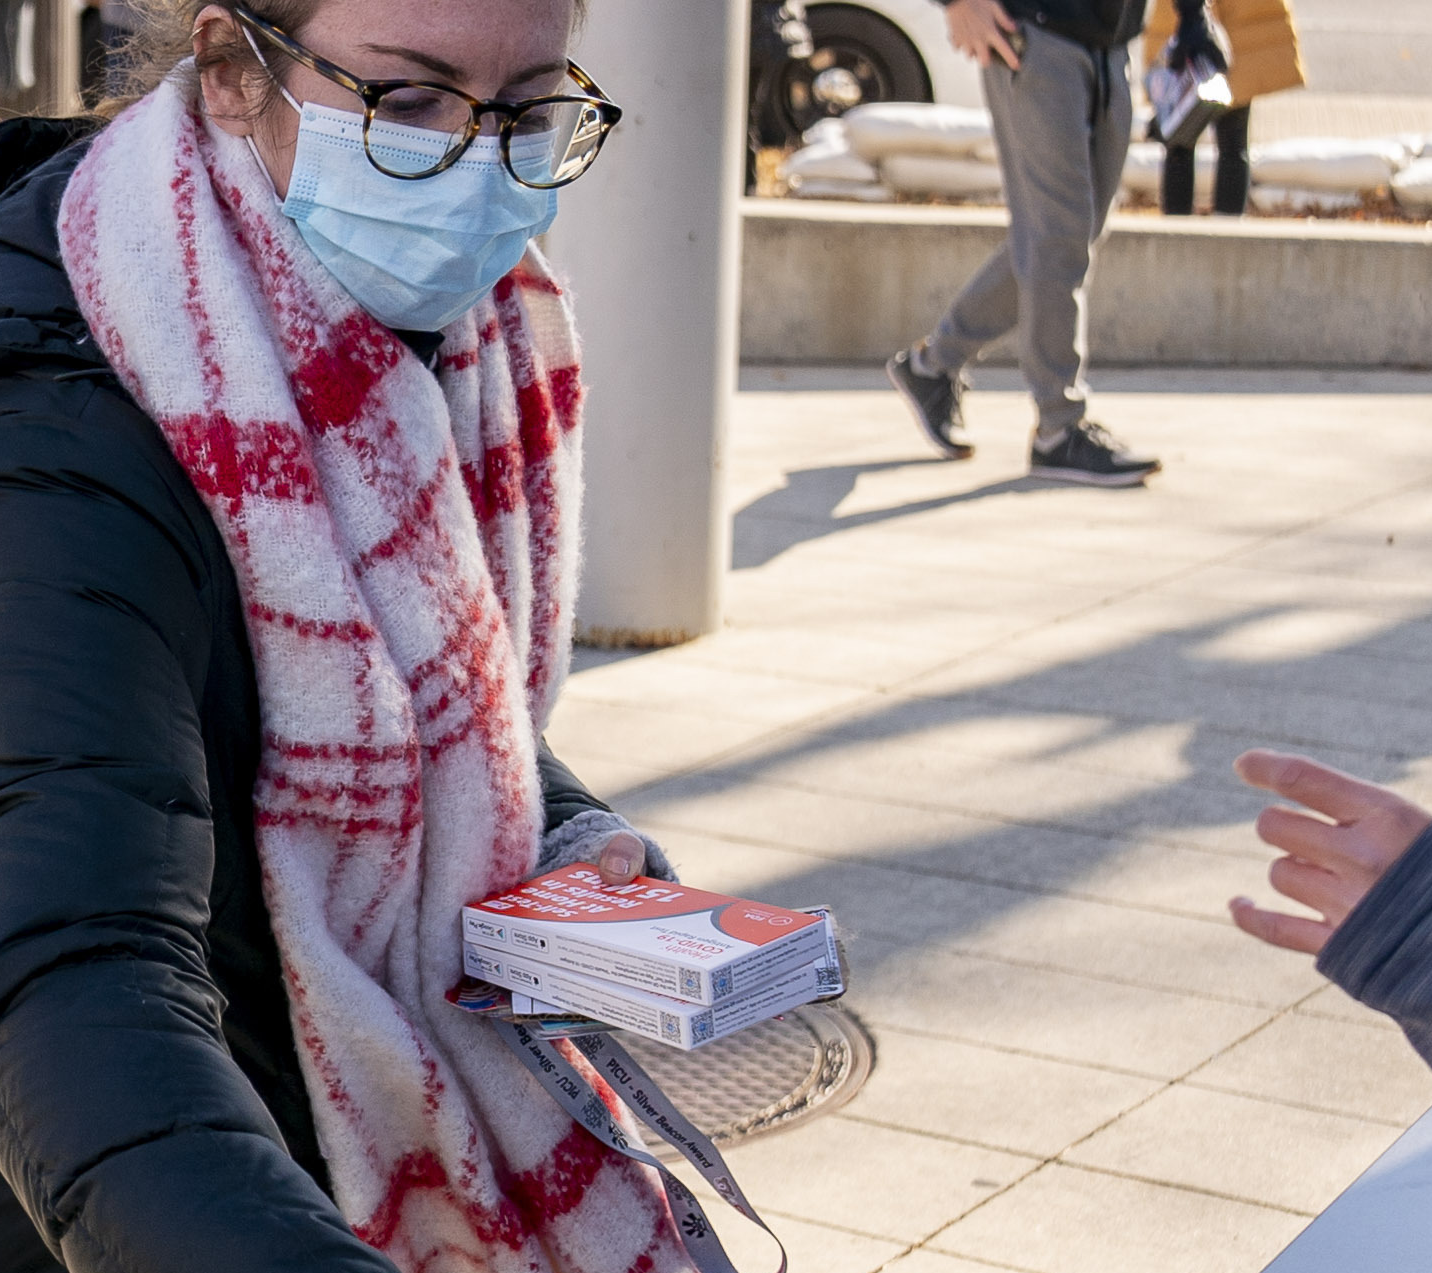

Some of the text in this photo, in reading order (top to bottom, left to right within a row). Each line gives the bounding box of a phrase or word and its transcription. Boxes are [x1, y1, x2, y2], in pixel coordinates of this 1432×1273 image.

[520, 886, 581, 909] Home
[540, 878, 644, 910] Results In
[636, 884, 686, 903] 15
[500, 894, 579, 918] Self-Test
[579, 903, 615, 915] At
[656, 934, 725, 955] COVID-19
[665, 943, 713, 962] iHealth
[512, 1023, 536, 1049] Bea
[531, 1044, 558, 1075] Silver
[557, 1075, 581, 1100] PICU
[605, 1057, 632, 1086] PICU
[632, 1088, 660, 1120] Silver
[653, 1112, 687, 1146] Beacon
[684, 1140, 714, 1169] Award
